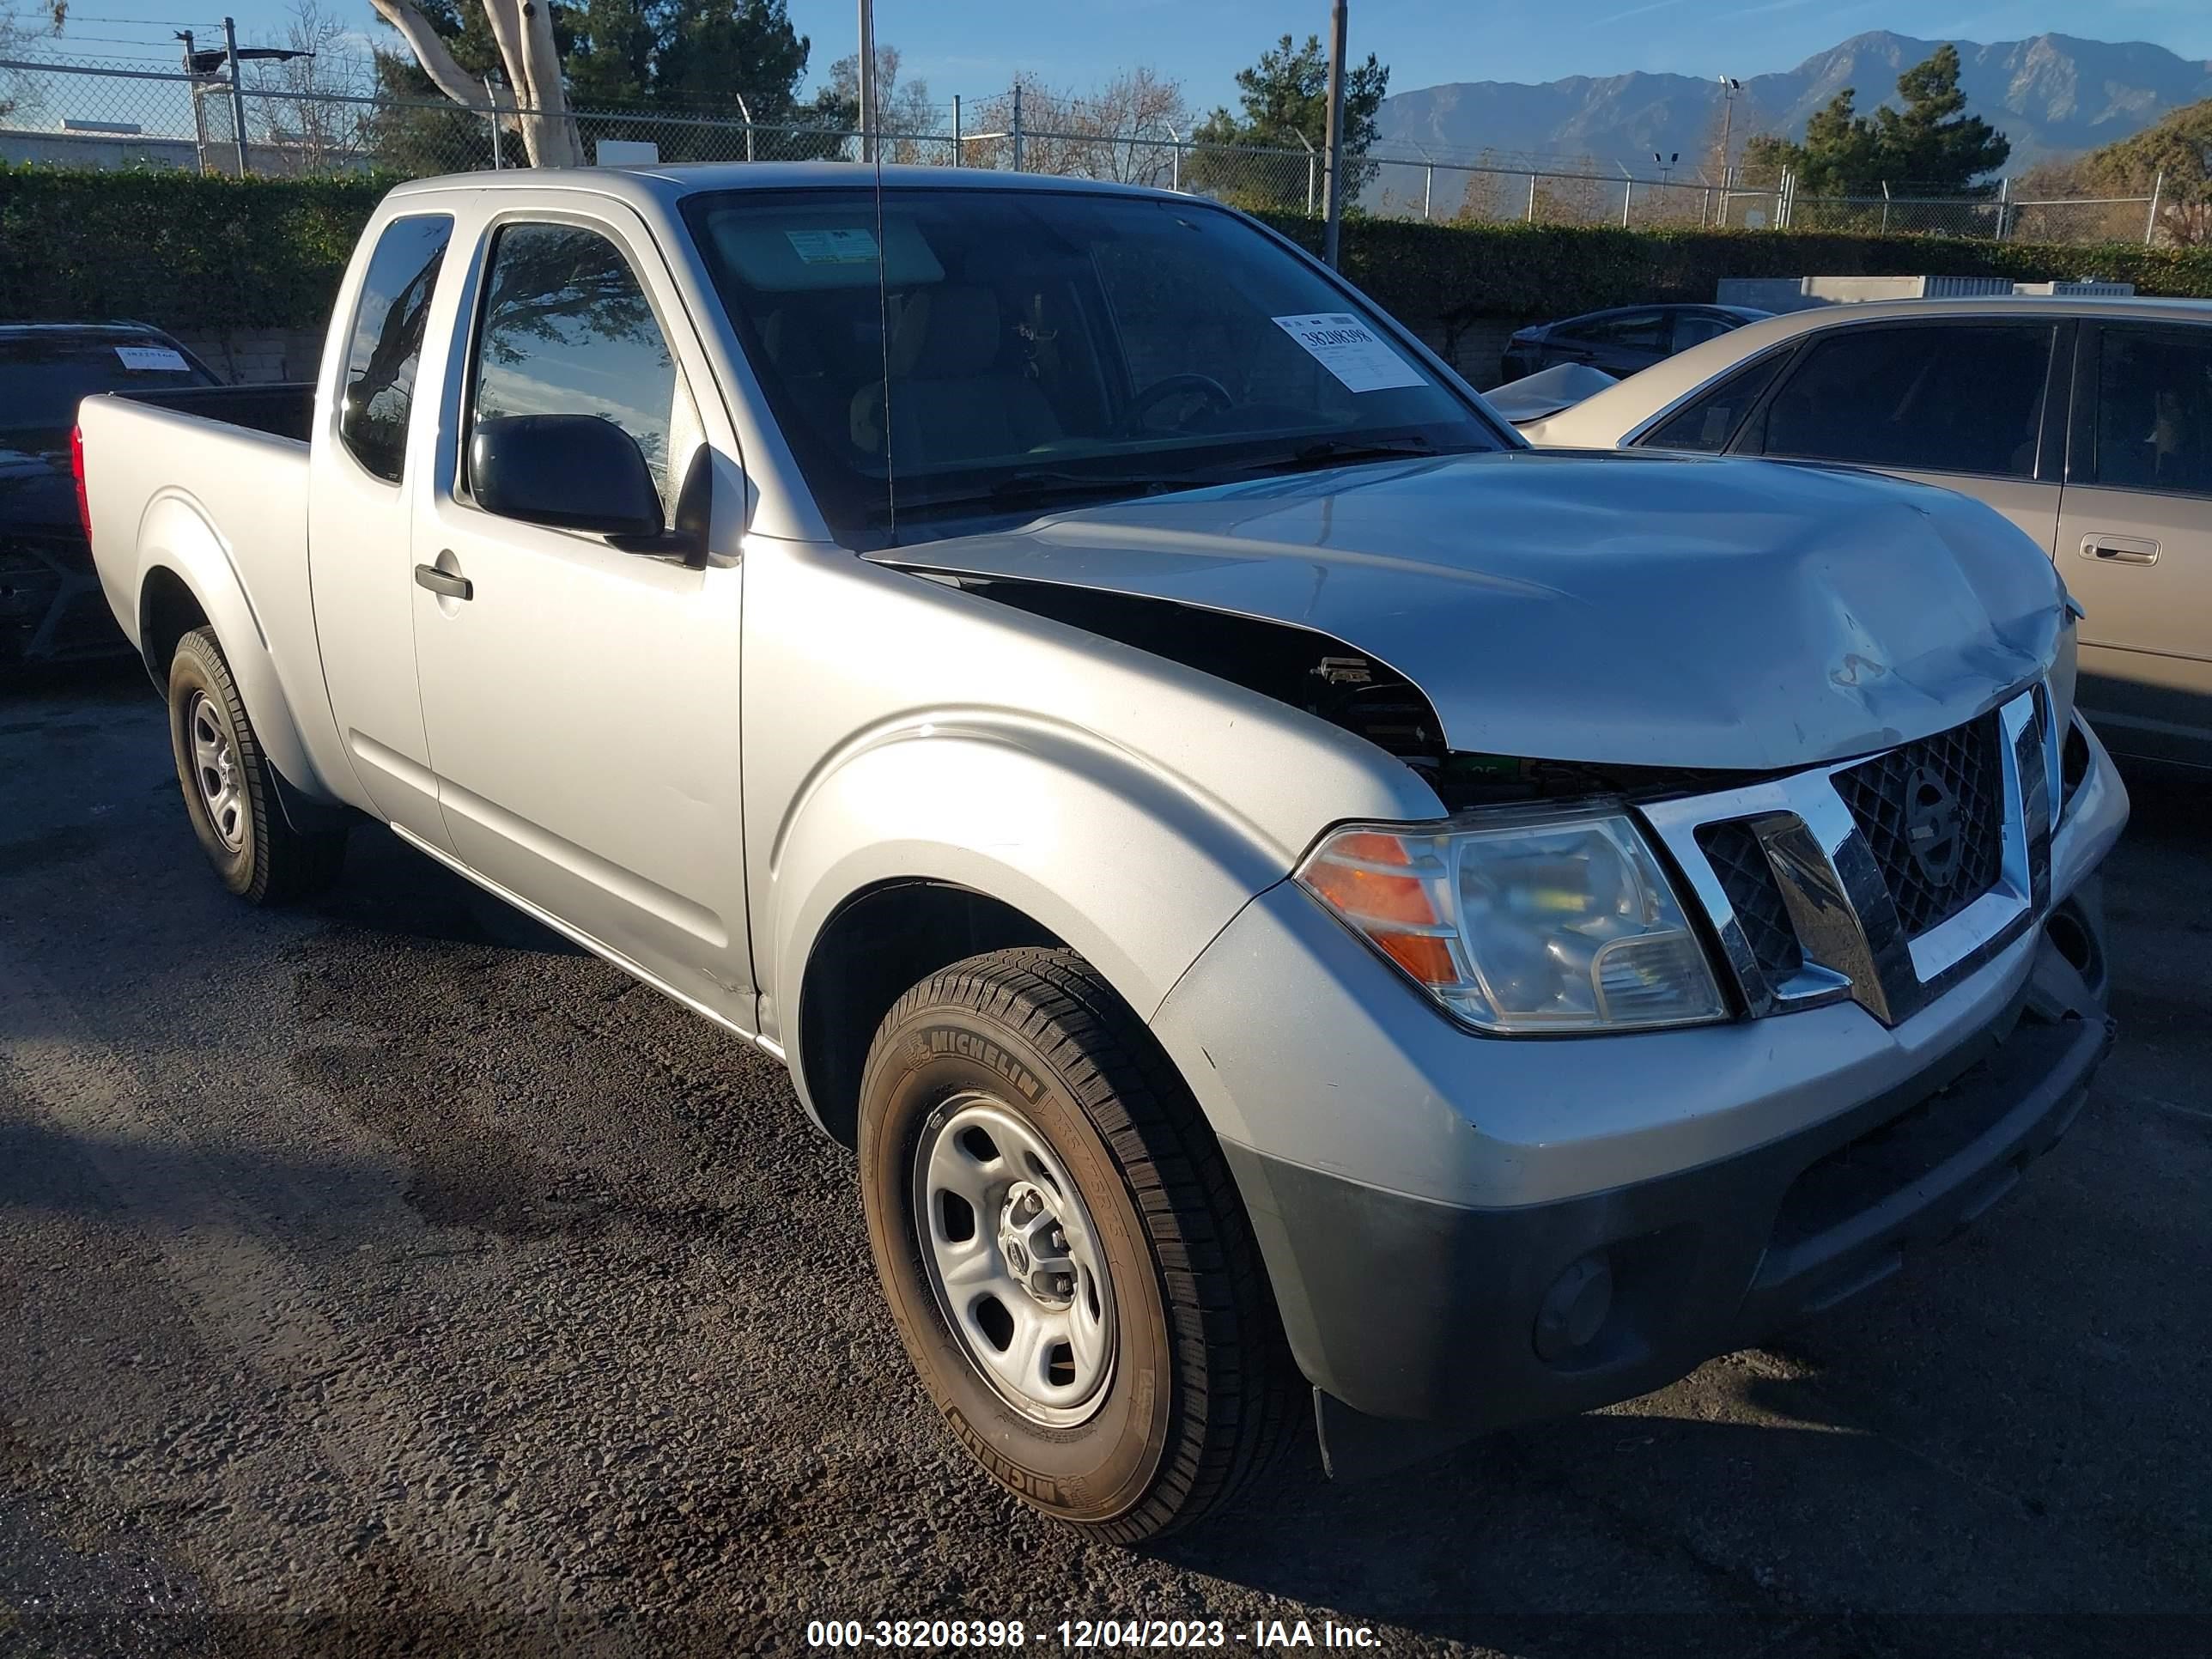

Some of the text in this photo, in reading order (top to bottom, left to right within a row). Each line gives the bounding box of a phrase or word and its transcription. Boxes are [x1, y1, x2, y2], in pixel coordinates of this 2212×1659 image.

[1301, 330, 1373, 346] 38208398
[932, 1031, 1039, 1097] MICHELIN
[949, 1413, 1055, 1505] MICHELIN
